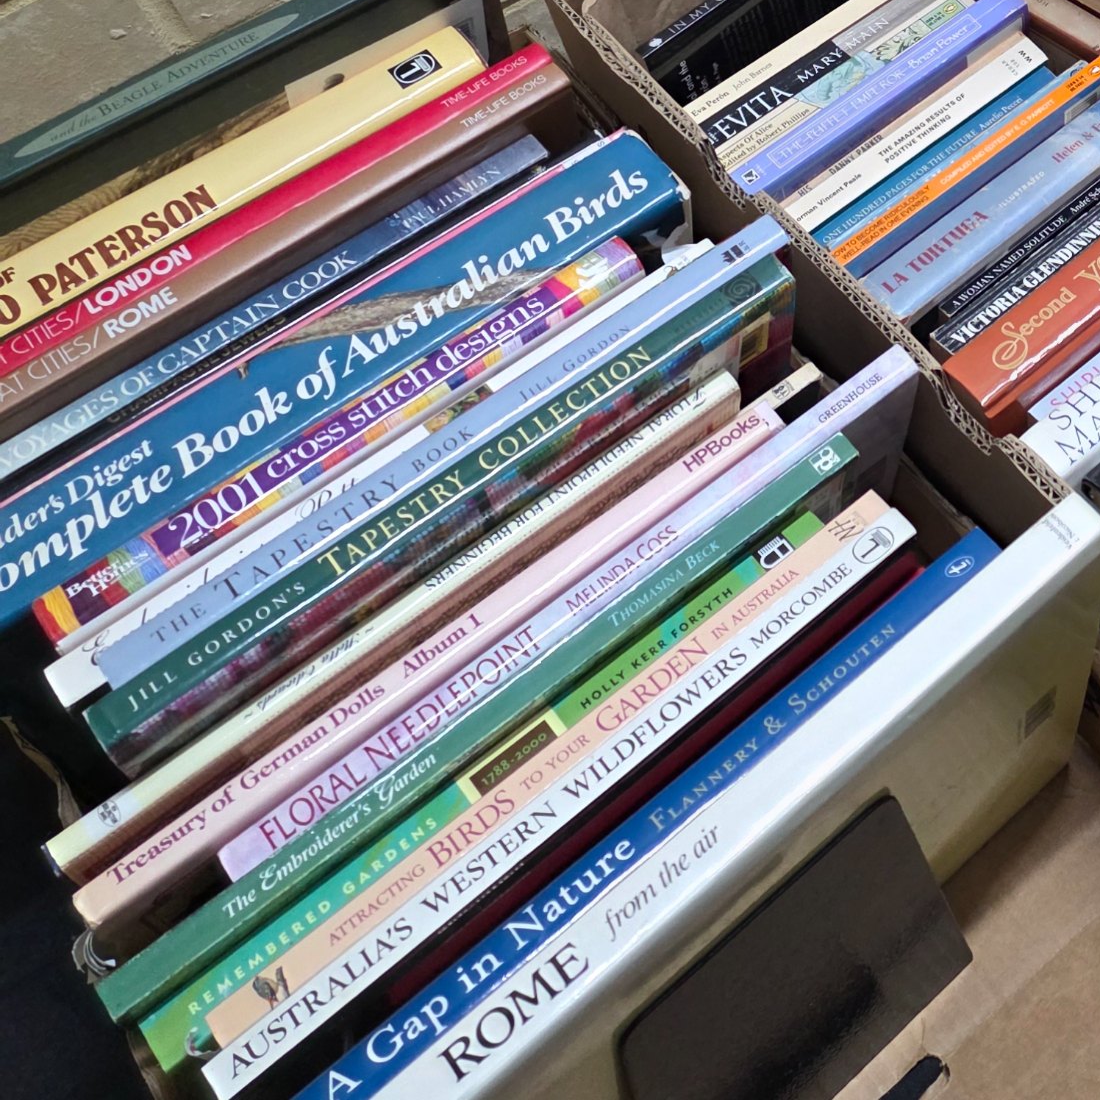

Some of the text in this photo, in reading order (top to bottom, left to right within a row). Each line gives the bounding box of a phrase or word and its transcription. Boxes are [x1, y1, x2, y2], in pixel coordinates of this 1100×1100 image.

[668, 18, 687, 35] IN
[689, 1, 711, 22] MY
[714, 84, 795, 141] EVITA
[796, 47, 843, 84] MARY
[845, 16, 890, 51] MAIN
[440, 55, 528, 109] TIME-LIFE BOOKS
[460, 74, 548, 129] TIME-LIFE BOOKS
[878, 92, 966, 158] THE AMAZING RESULTS OF
[884, 113, 952, 164] POSITIVE THINKING
[10, 244, 192, 355] CITIES/LONDON
[27, 184, 220, 306] PATERSON
[31, 286, 178, 381] CITIES/ROME
[951, 284, 1025, 345] VICTORIA
[992, 286, 1078, 372] Second
[0, 458, 173, 592] omplete
[171, 386, 293, 479] Book
[296, 347, 337, 400] of
[340, 232, 550, 378] Australian
[543, 167, 648, 243] Birds
[167, 475, 265, 548] 2001
[267, 419, 347, 481] cross
[347, 359, 437, 430] stitch
[436, 293, 545, 377] designs
[127, 672, 179, 712] JILL
[187, 581, 307, 667] GORDON'S
[317, 468, 470, 577] TAPESTRY
[477, 344, 654, 472] COLLECTION
[151, 425, 475, 644] THE TAPESTRY BOOK
[106, 809, 210, 886] Treasury
[210, 783, 236, 814] of
[238, 723, 331, 791] German
[328, 682, 387, 729] Dolls
[401, 623, 469, 680] Album
[468, 612, 485, 633] 1
[682, 413, 761, 474] HPBooks
[222, 539, 721, 919] The Embroiderer's Garden THOMASINA BECK
[328, 568, 801, 947] ATTRACTING BIRDS TO YOUR GARDEN IN AUSTRALIA
[187, 587, 734, 1016] REMEMBERED GARDENS 1788-2000 HOLLY KERR FORSYTH
[230, 563, 853, 1079] AUSTRALIA'S WESTERN WILDFLOWERS MORCOMBE
[435, 823, 721, 1084] ROME from the air
